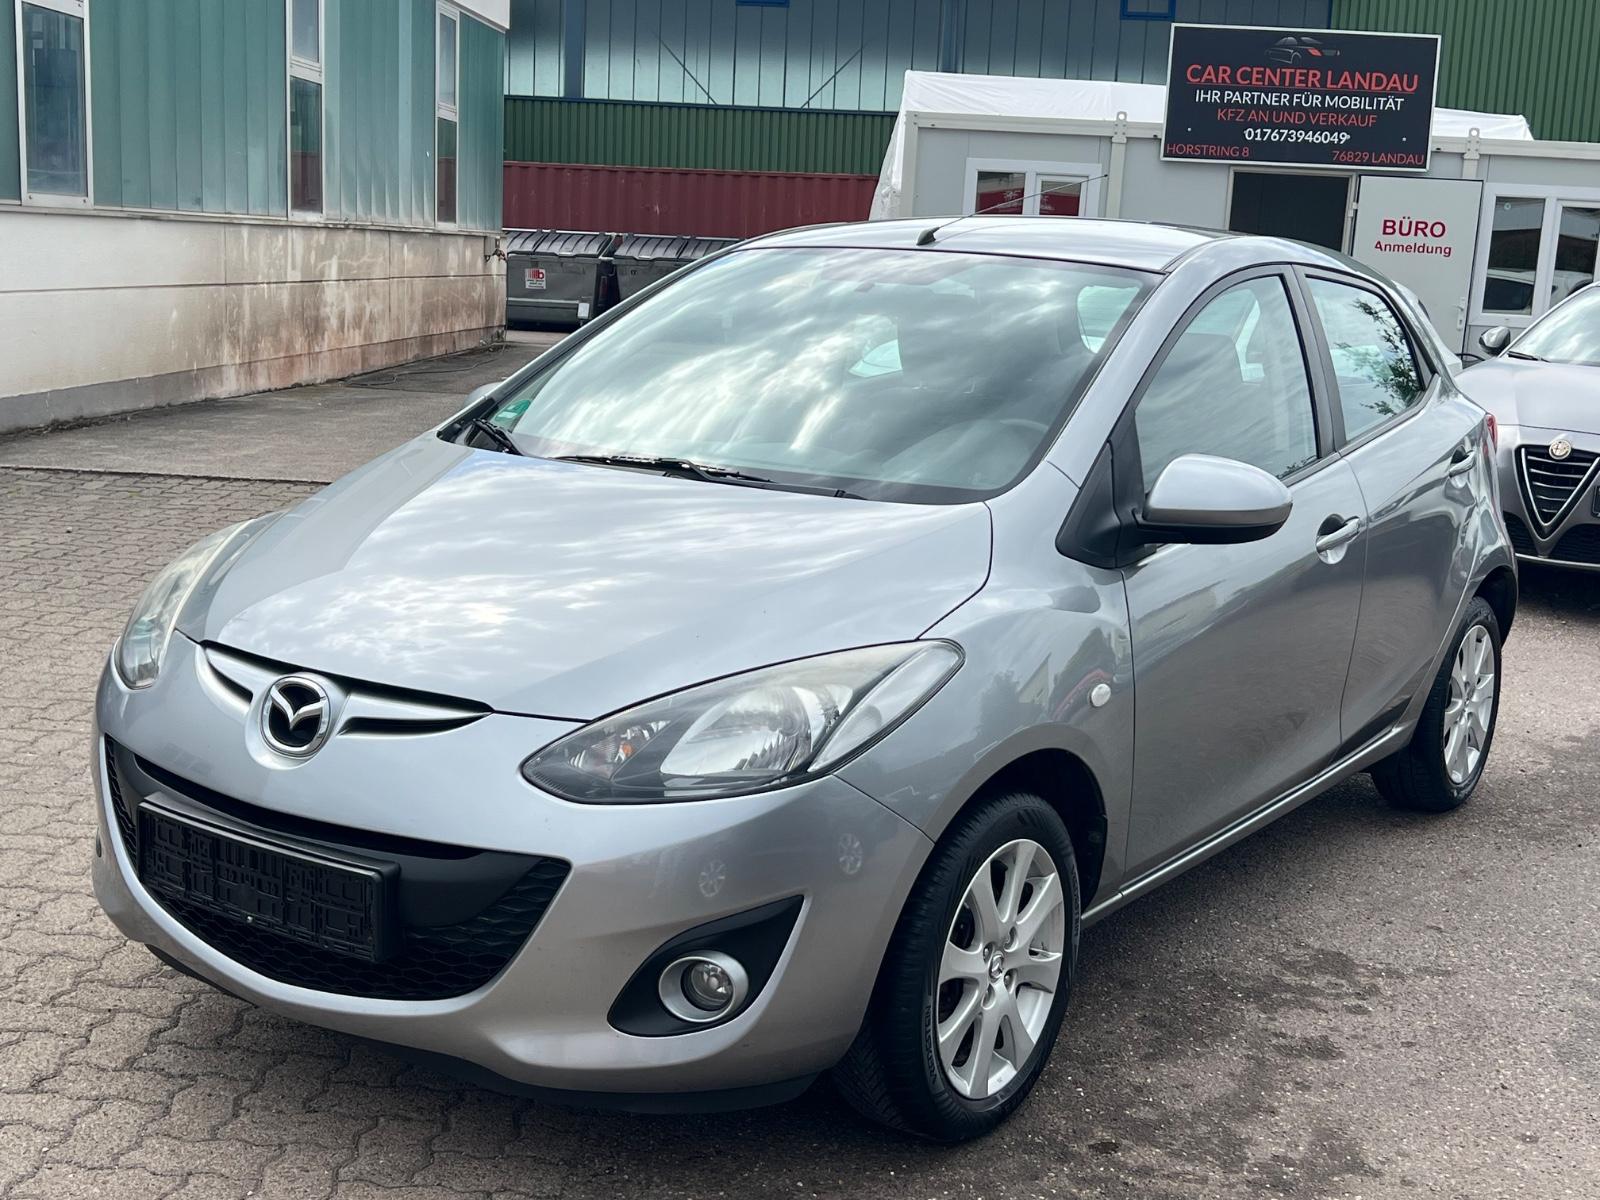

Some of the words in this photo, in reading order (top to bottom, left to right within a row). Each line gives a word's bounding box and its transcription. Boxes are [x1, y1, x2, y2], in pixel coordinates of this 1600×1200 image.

[1186, 64, 1231, 84] CAR
[1236, 66, 1320, 88] CENTER
[1326, 70, 1418, 92] LANDAU
[1195, 89, 1220, 103] IHR
[1224, 90, 1289, 106] PARTNER
[1292, 91, 1321, 108] FÜR
[1324, 95, 1404, 111] MOBILITÄT
[1217, 108, 1245, 122] KFZ
[1248, 109, 1269, 123] AN
[1272, 111, 1305, 124] UND
[1309, 112, 1377, 127] VERKAUF
[1245, 127, 1347, 145] 017673946049
[1166, 143, 1239, 157] HORSTRING
[1241, 146, 1250, 158] 8
[1332, 150, 1369, 163] 76829
[1372, 152, 1424, 165] LANDAU
[1382, 216, 1446, 238] BÜRO
[1375, 240, 1452, 258] Anmeldung
